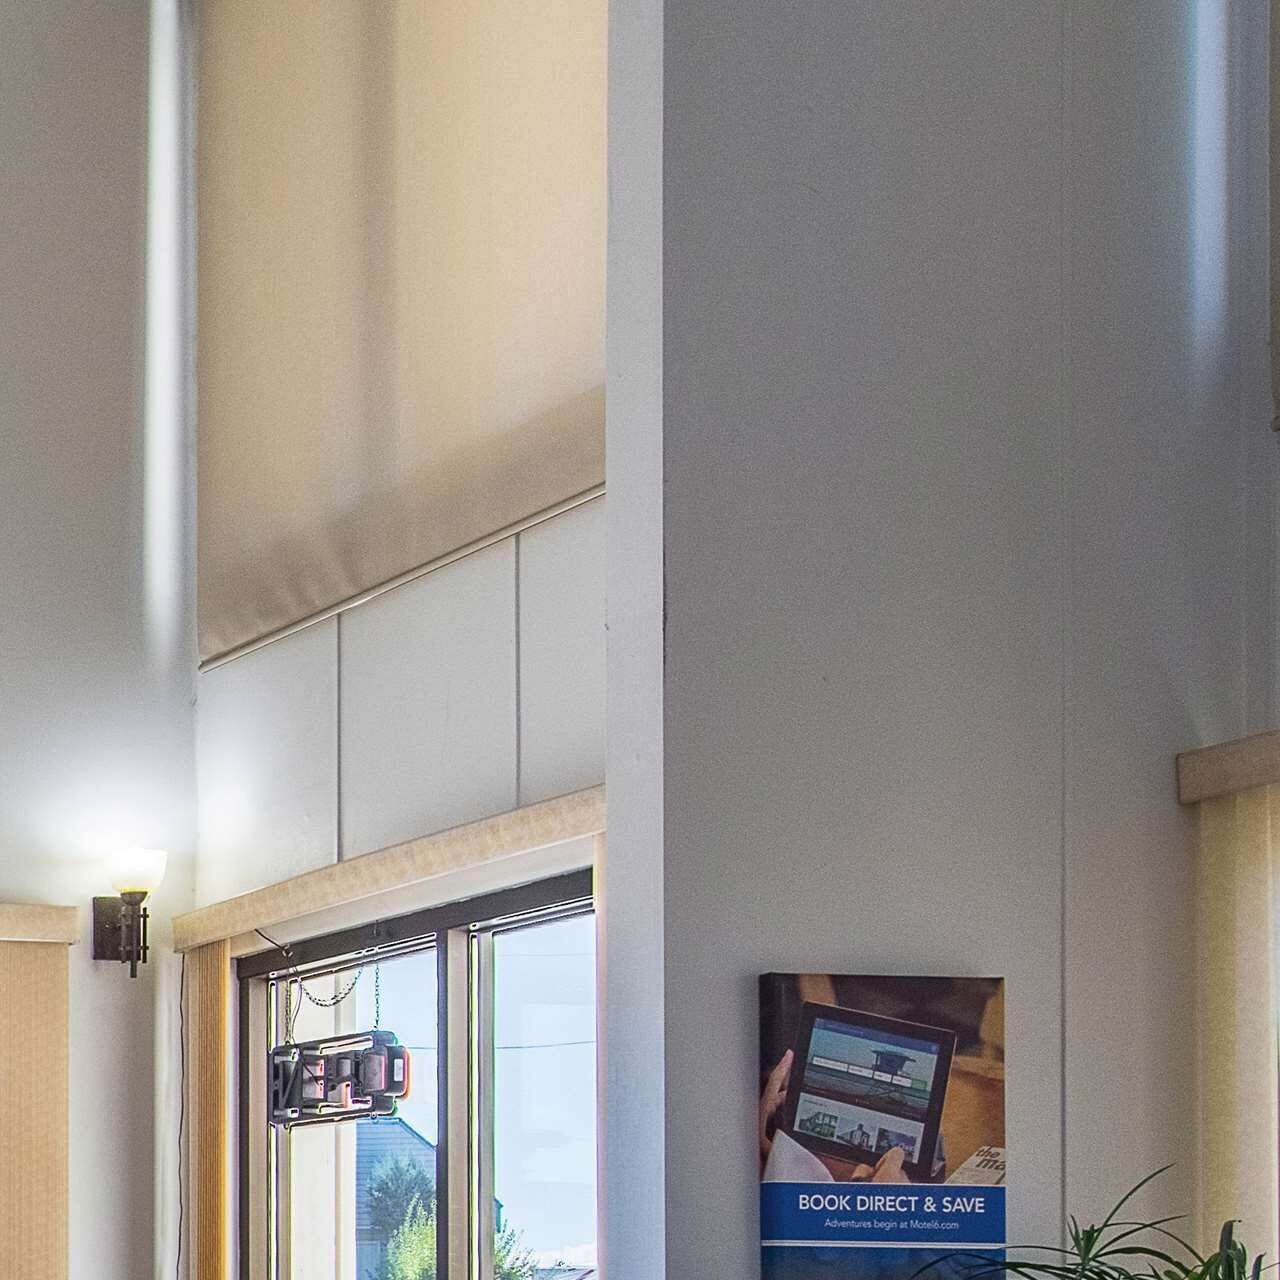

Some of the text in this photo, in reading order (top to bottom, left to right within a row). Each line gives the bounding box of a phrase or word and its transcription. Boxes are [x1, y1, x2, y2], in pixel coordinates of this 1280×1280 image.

[976, 1146, 1000, 1158] the
[799, 1195, 985, 1213] BOOK DIRECT & SAVE
[824, 1218, 959, 1230] Adventures begin at Motel6.com
